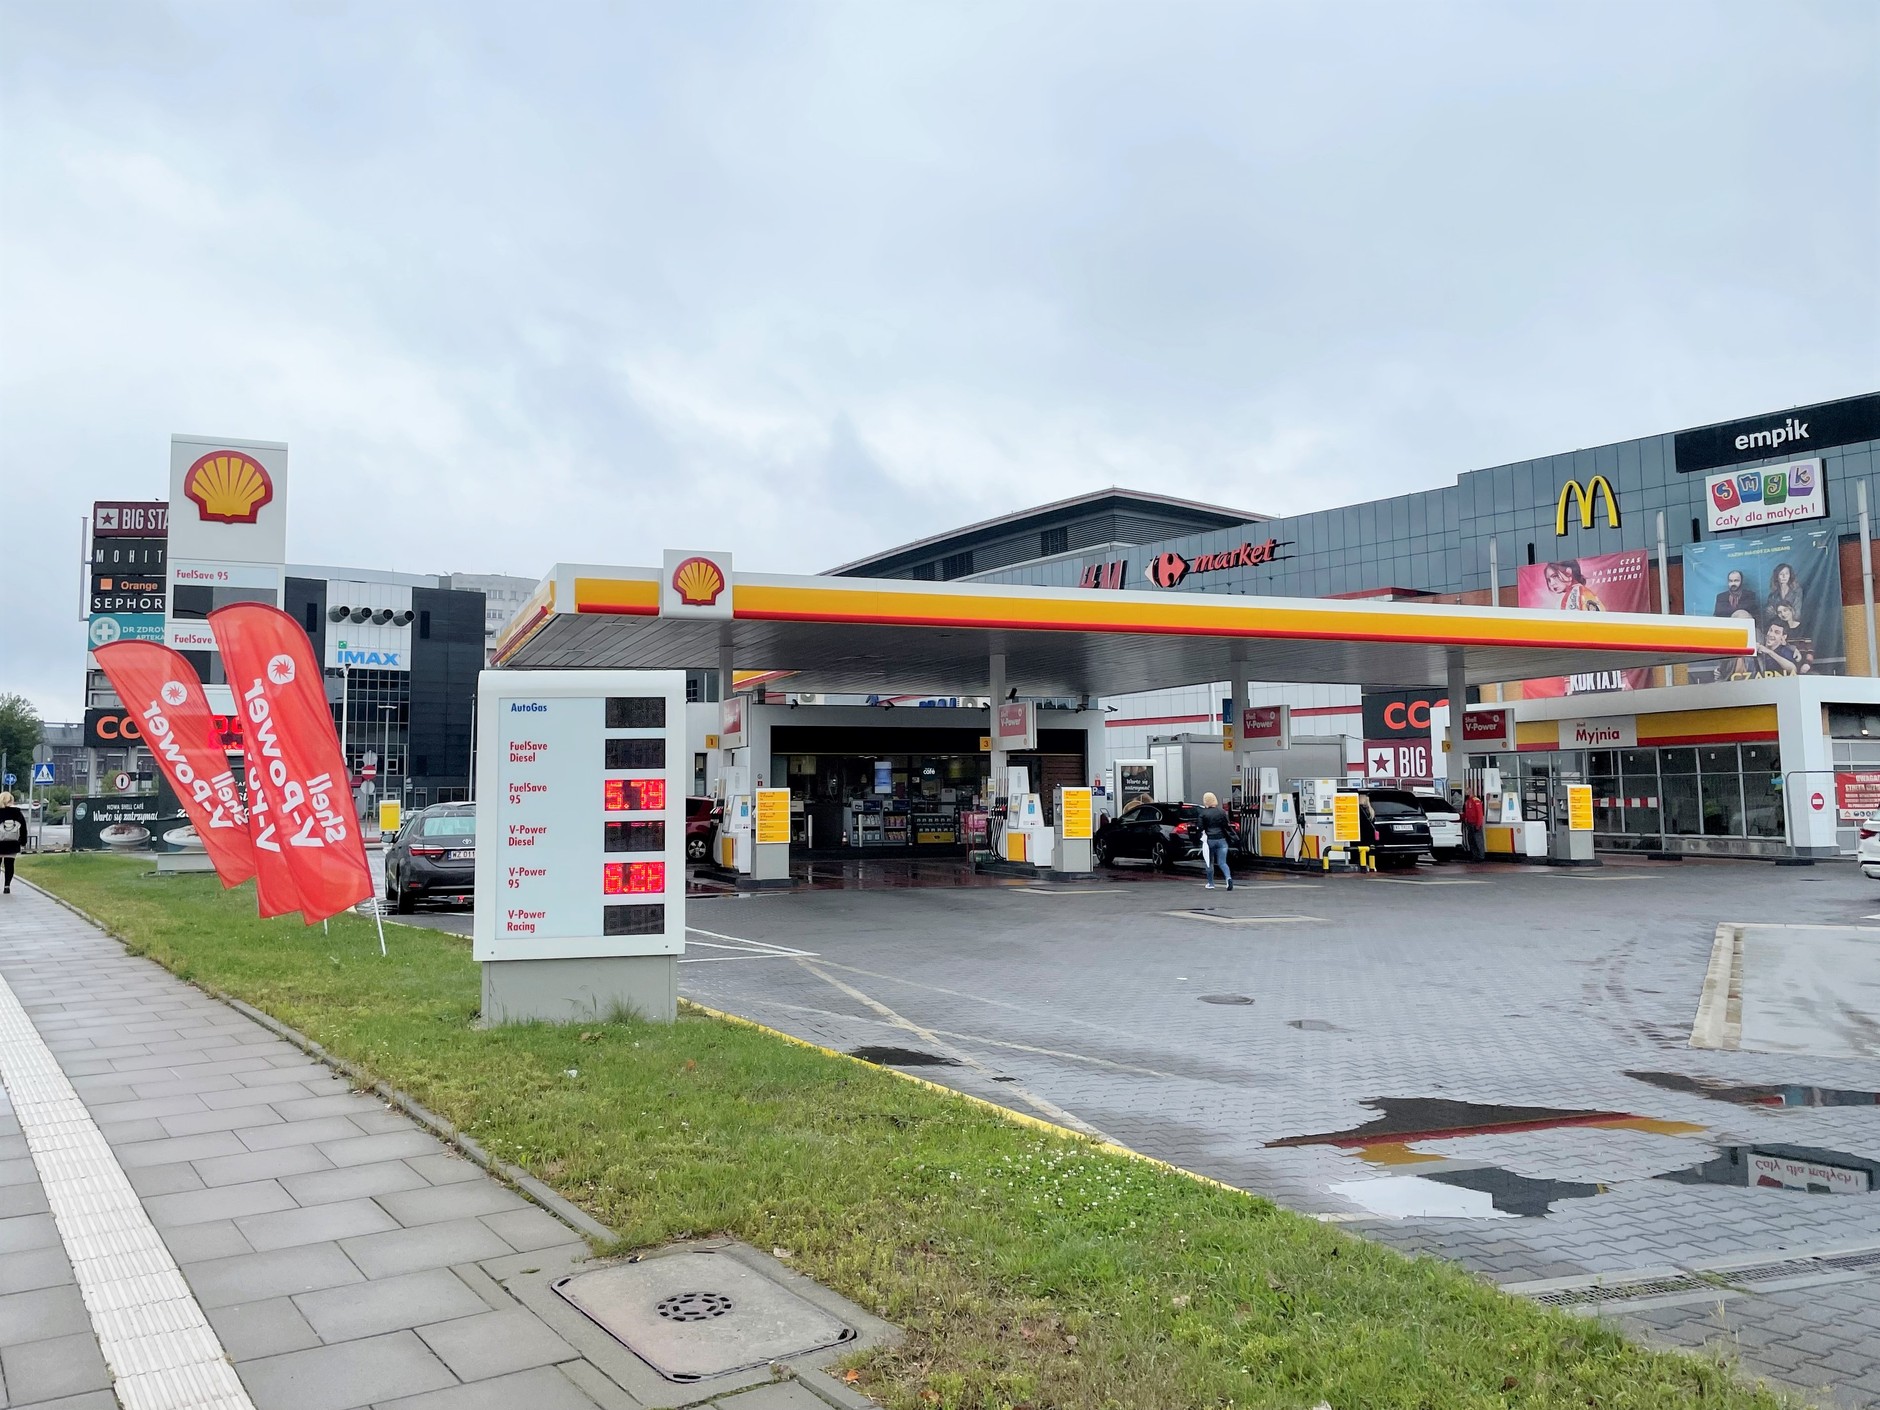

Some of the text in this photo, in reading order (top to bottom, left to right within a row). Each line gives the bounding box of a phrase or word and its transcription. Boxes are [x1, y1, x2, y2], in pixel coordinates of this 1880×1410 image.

[1735, 418, 1810, 450] empik
[122, 508, 169, 530] BIG STA
[1715, 514, 1740, 527] Cały
[1745, 511, 1763, 522] dla
[1766, 504, 1809, 519] małych
[95, 549, 163, 563] MOHIT
[1193, 538, 1276, 573] market
[1620, 557, 1641, 565] CZAS
[176, 569, 229, 581] FuelSave 95
[1607, 565, 1641, 576] NOWEGO
[1591, 573, 1643, 585] TARANTINO!
[120, 581, 158, 592] Orange
[94, 598, 163, 609] SEPHOR
[174, 633, 212, 645] FuelSave
[338, 650, 399, 666] IMAX
[510, 702, 548, 712] AutoGas
[96, 715, 142, 739] CC
[1245, 720, 1273, 729] V-Power
[1465, 722, 1498, 732] V-Power
[1575, 727, 1620, 745] Myjnia
[509, 740, 548, 750] FuelSave
[984, 740, 989, 748] 3
[509, 752, 536, 763] Diesel
[1400, 746, 1426, 777] BIG
[509, 782, 548, 793] FuelSave
[509, 794, 521, 804] 95
[509, 824, 547, 834] V-Power
[508, 836, 535, 847] Diesel
[508, 866, 547, 877] V-Power
[508, 879, 520, 889] 95
[507, 909, 546, 919] V-Power
[507, 921, 536, 933] Racing
